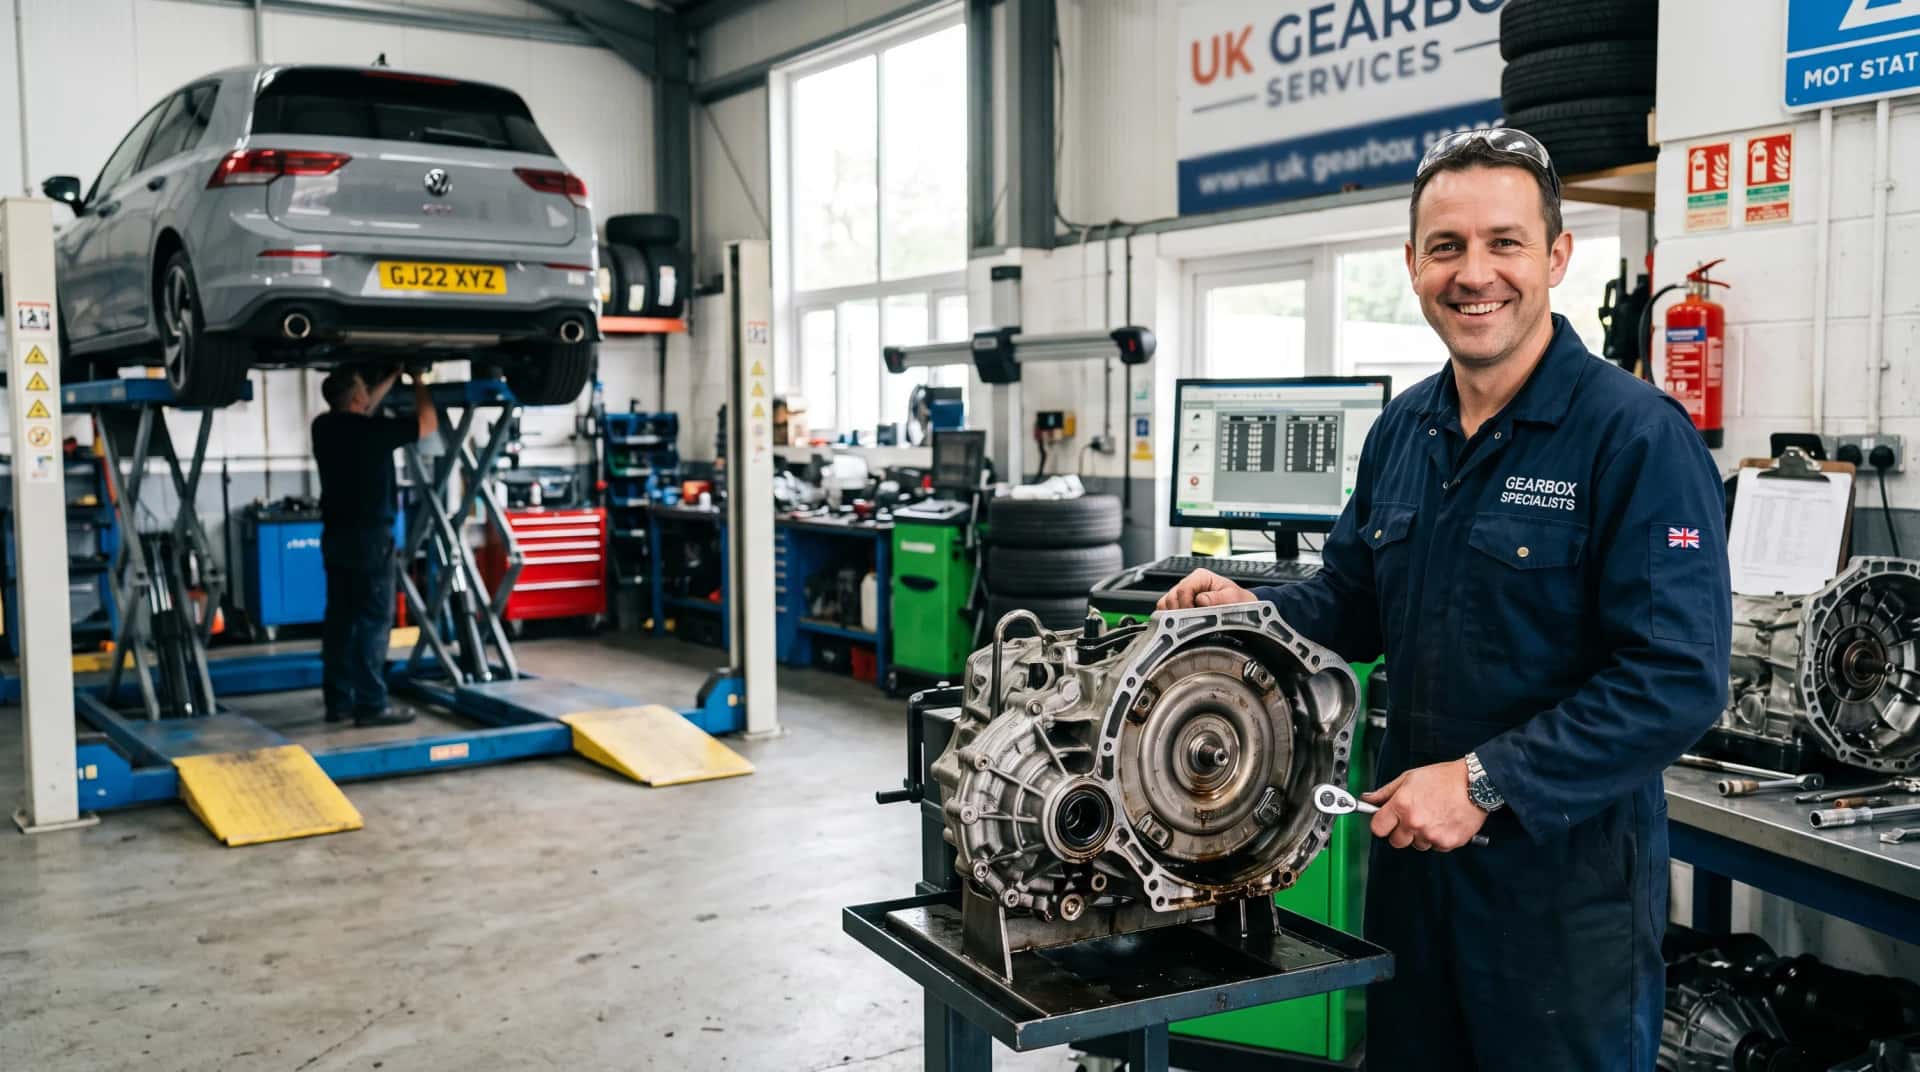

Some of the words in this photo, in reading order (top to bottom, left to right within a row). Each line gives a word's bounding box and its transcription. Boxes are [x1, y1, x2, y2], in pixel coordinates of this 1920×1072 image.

[1190, 24, 1255, 86] UK
[1268, 0, 1502, 64] GEARB
[1265, 40, 1442, 108] SERVICES
[1803, 63, 1854, 90] MOT
[1860, 51, 1919, 80] STAT
[1312, 136, 1417, 184] gearbox
[389, 264, 448, 287] GJ22
[455, 268, 497, 291] XYZ
[1499, 490, 1577, 512] SPECIALISTS
[1504, 475, 1578, 498] GEARBOX
